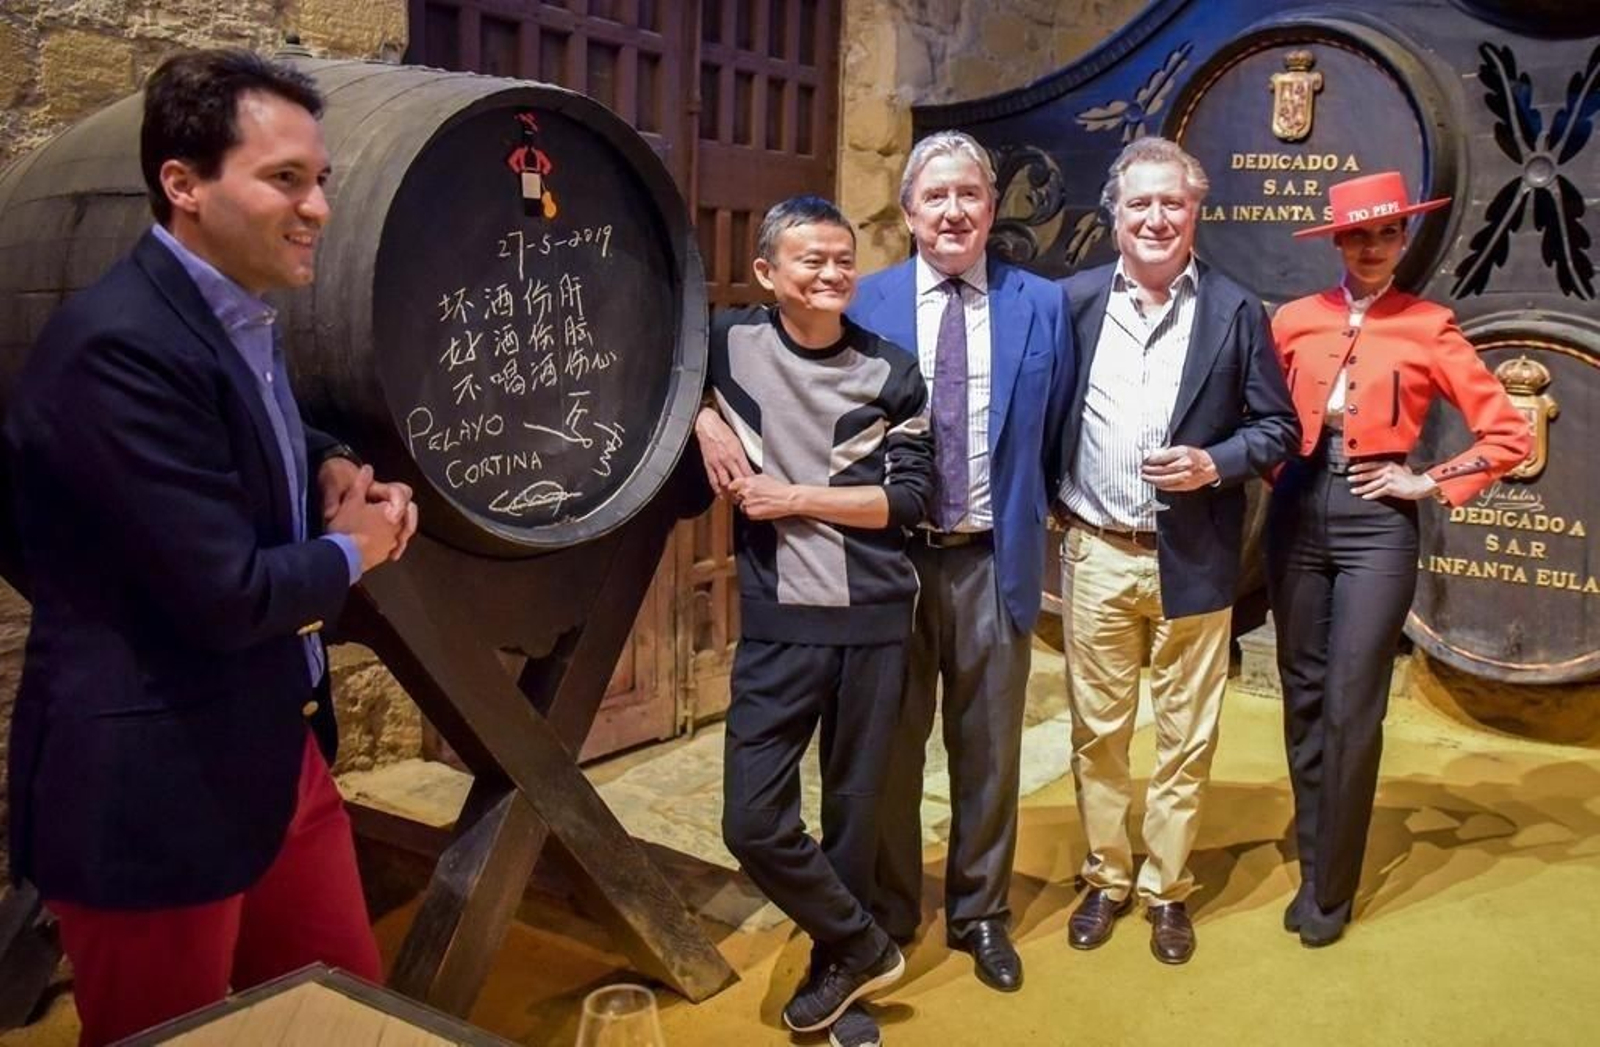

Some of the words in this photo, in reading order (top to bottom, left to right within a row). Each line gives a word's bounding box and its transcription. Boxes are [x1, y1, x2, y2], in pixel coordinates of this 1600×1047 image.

[1231, 154, 1338, 171] DEDICADO
[1342, 154, 1360, 171] A
[1263, 179, 1322, 196] S.A.R.
[1201, 205, 1226, 220] LA
[1232, 205, 1315, 221] INFANTA
[1348, 208, 1369, 223] TIO
[446, 451, 543, 489] CORTINA
[1450, 506, 1565, 531] DEDICADO
[1569, 520, 1586, 537] A
[1429, 555, 1528, 583] INFANTA
[1536, 569, 1600, 593] EULA
